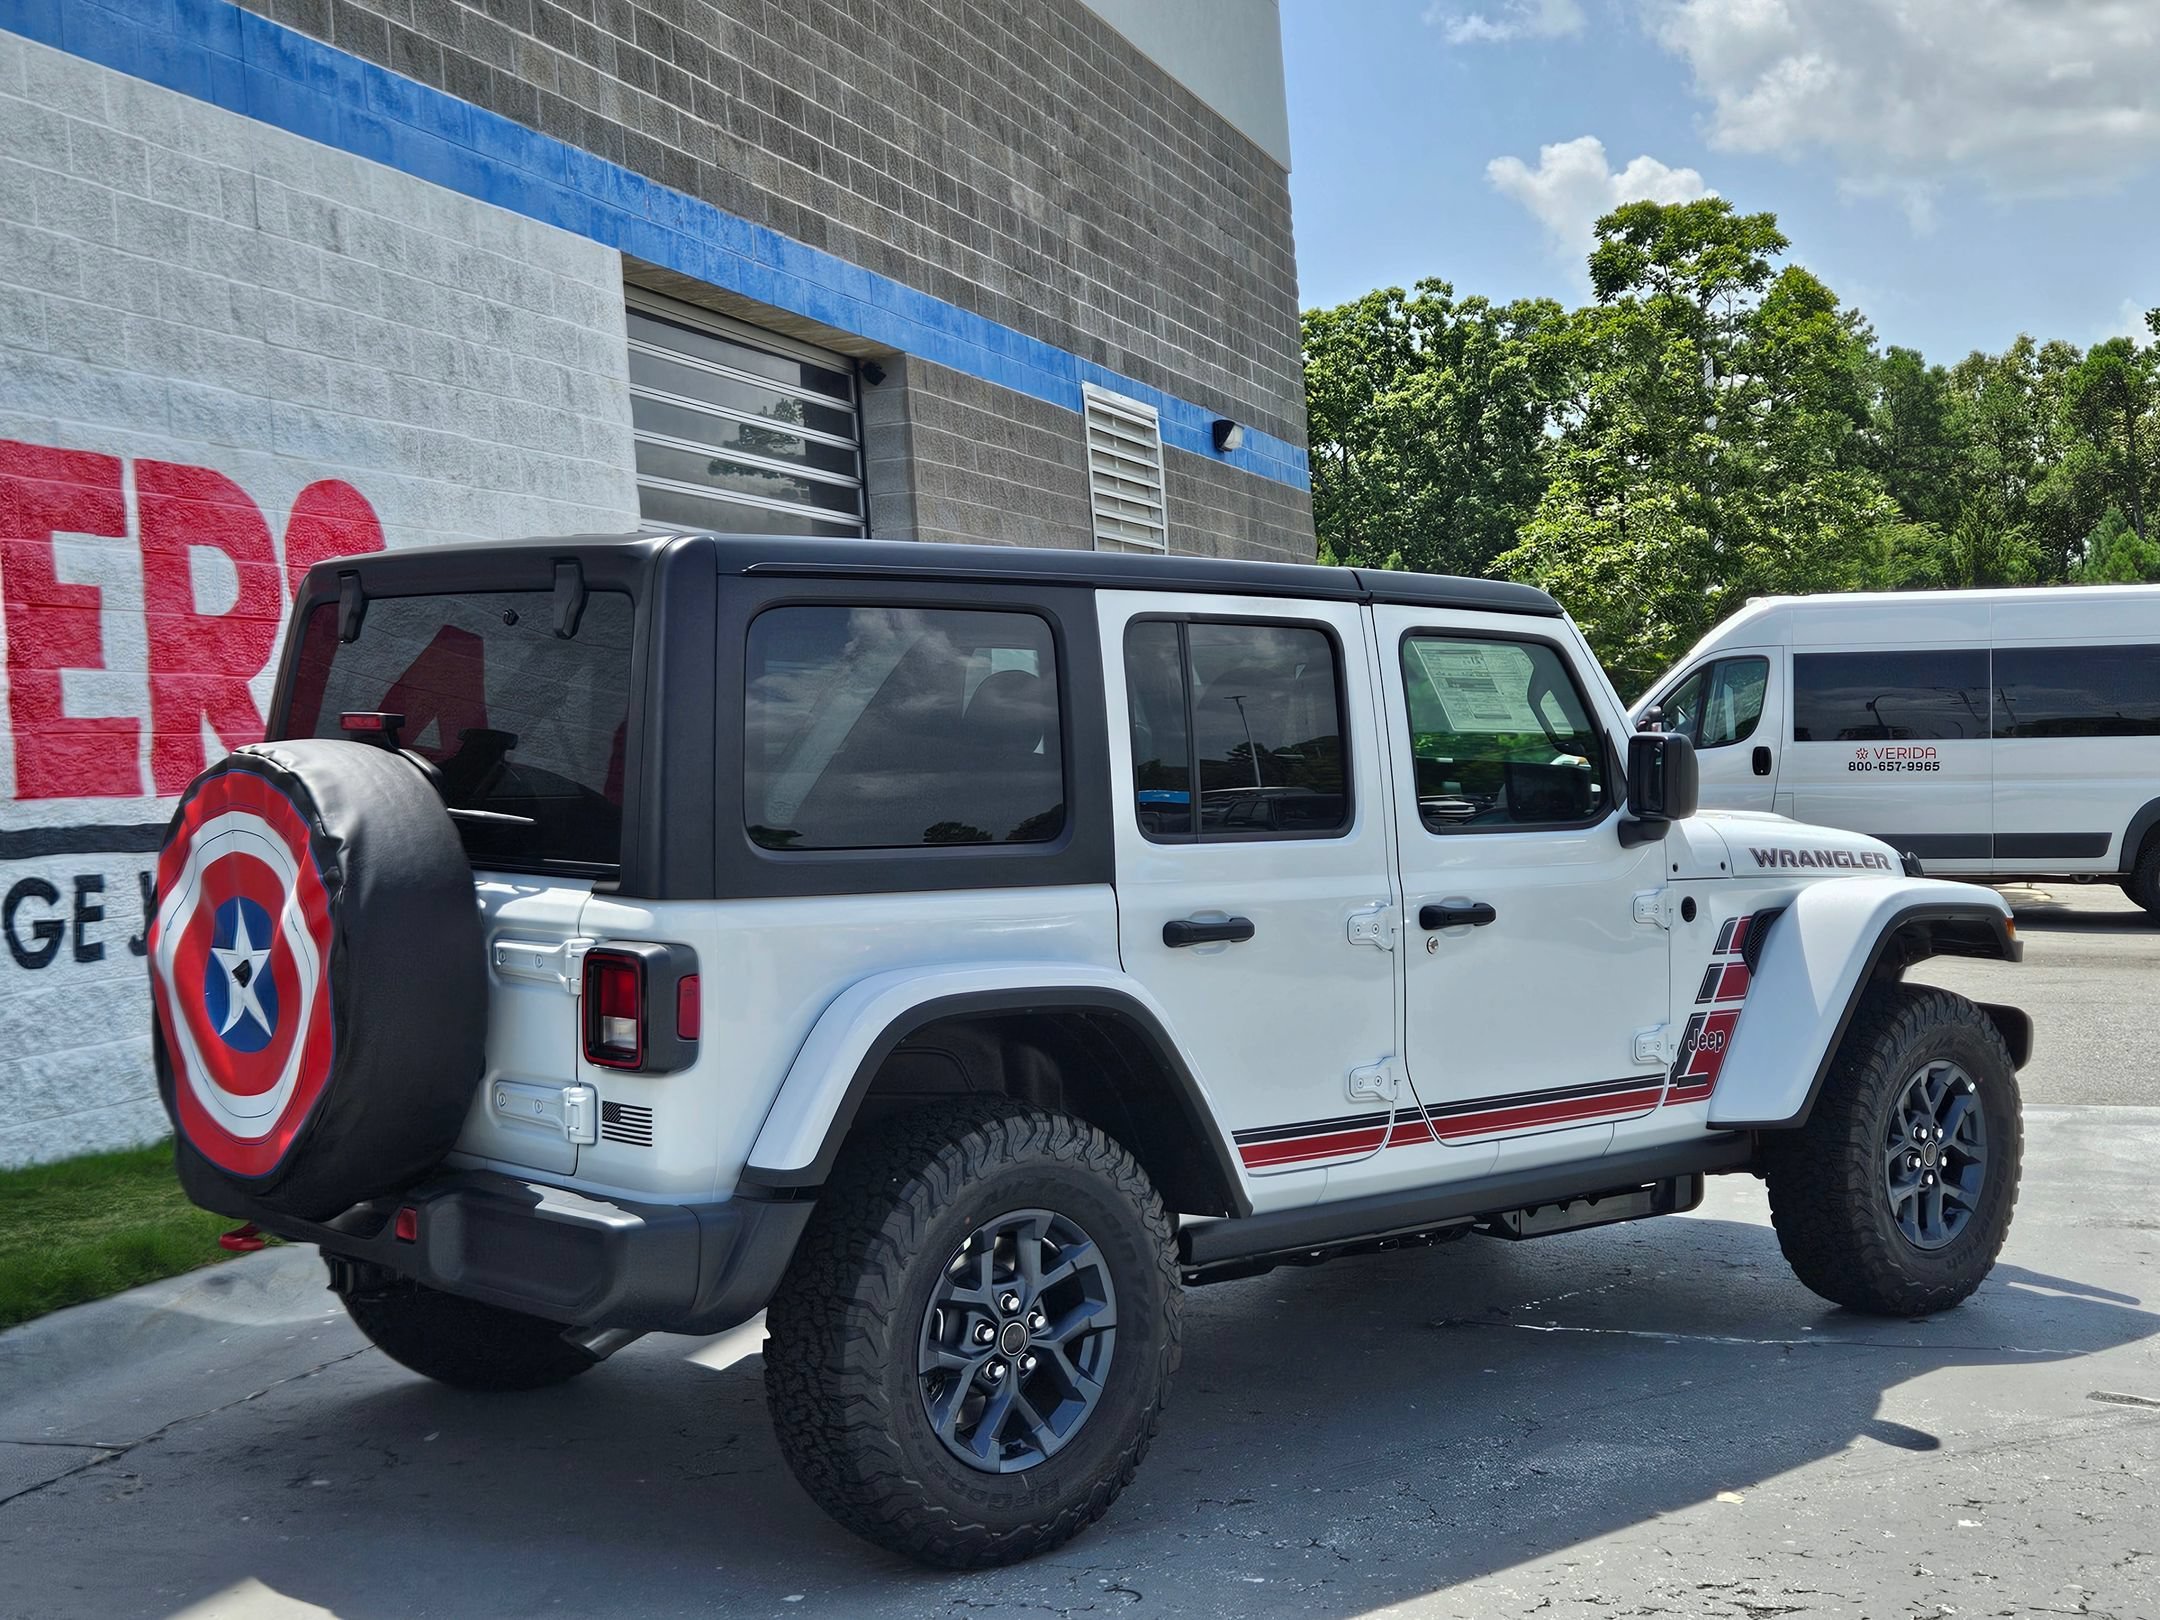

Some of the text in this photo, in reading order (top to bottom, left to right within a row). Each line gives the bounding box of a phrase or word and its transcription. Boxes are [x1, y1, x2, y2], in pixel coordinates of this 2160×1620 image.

[1873, 747, 1937, 760] VERIDA
[1848, 761, 1940, 772] 800-657-9965
[1749, 847, 1892, 870] WRANGLER
[1687, 1028, 1726, 1054] Jeep
